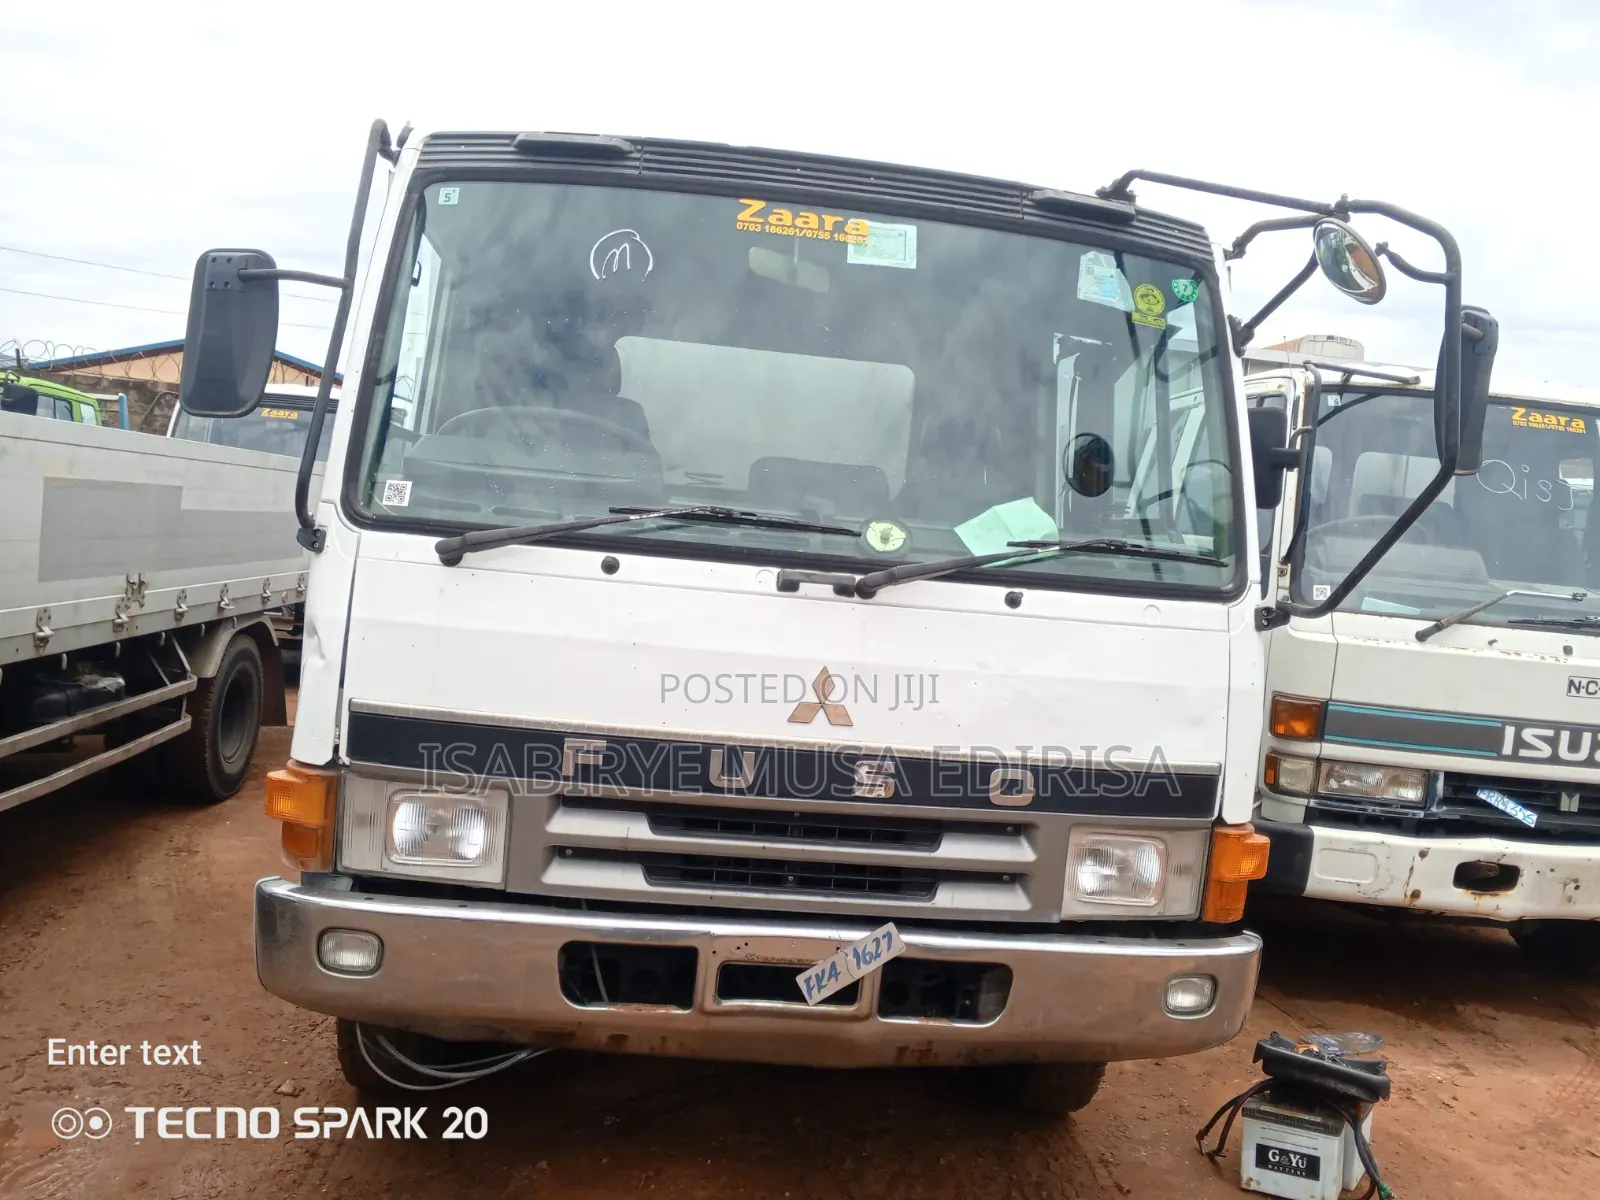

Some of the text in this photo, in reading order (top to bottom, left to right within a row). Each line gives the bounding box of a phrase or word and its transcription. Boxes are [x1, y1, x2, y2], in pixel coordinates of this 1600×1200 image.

[736, 221, 762, 233] 0703
[737, 198, 868, 236] Zaara
[261, 407, 299, 419] Zaara
[1510, 406, 1586, 429] Zaara
[1502, 725, 1600, 763] ISU
[561, 738, 1036, 806] FUSO
[804, 930, 893, 1001] FKA 1627
[1268, 1164, 1307, 1176] BATTERY
